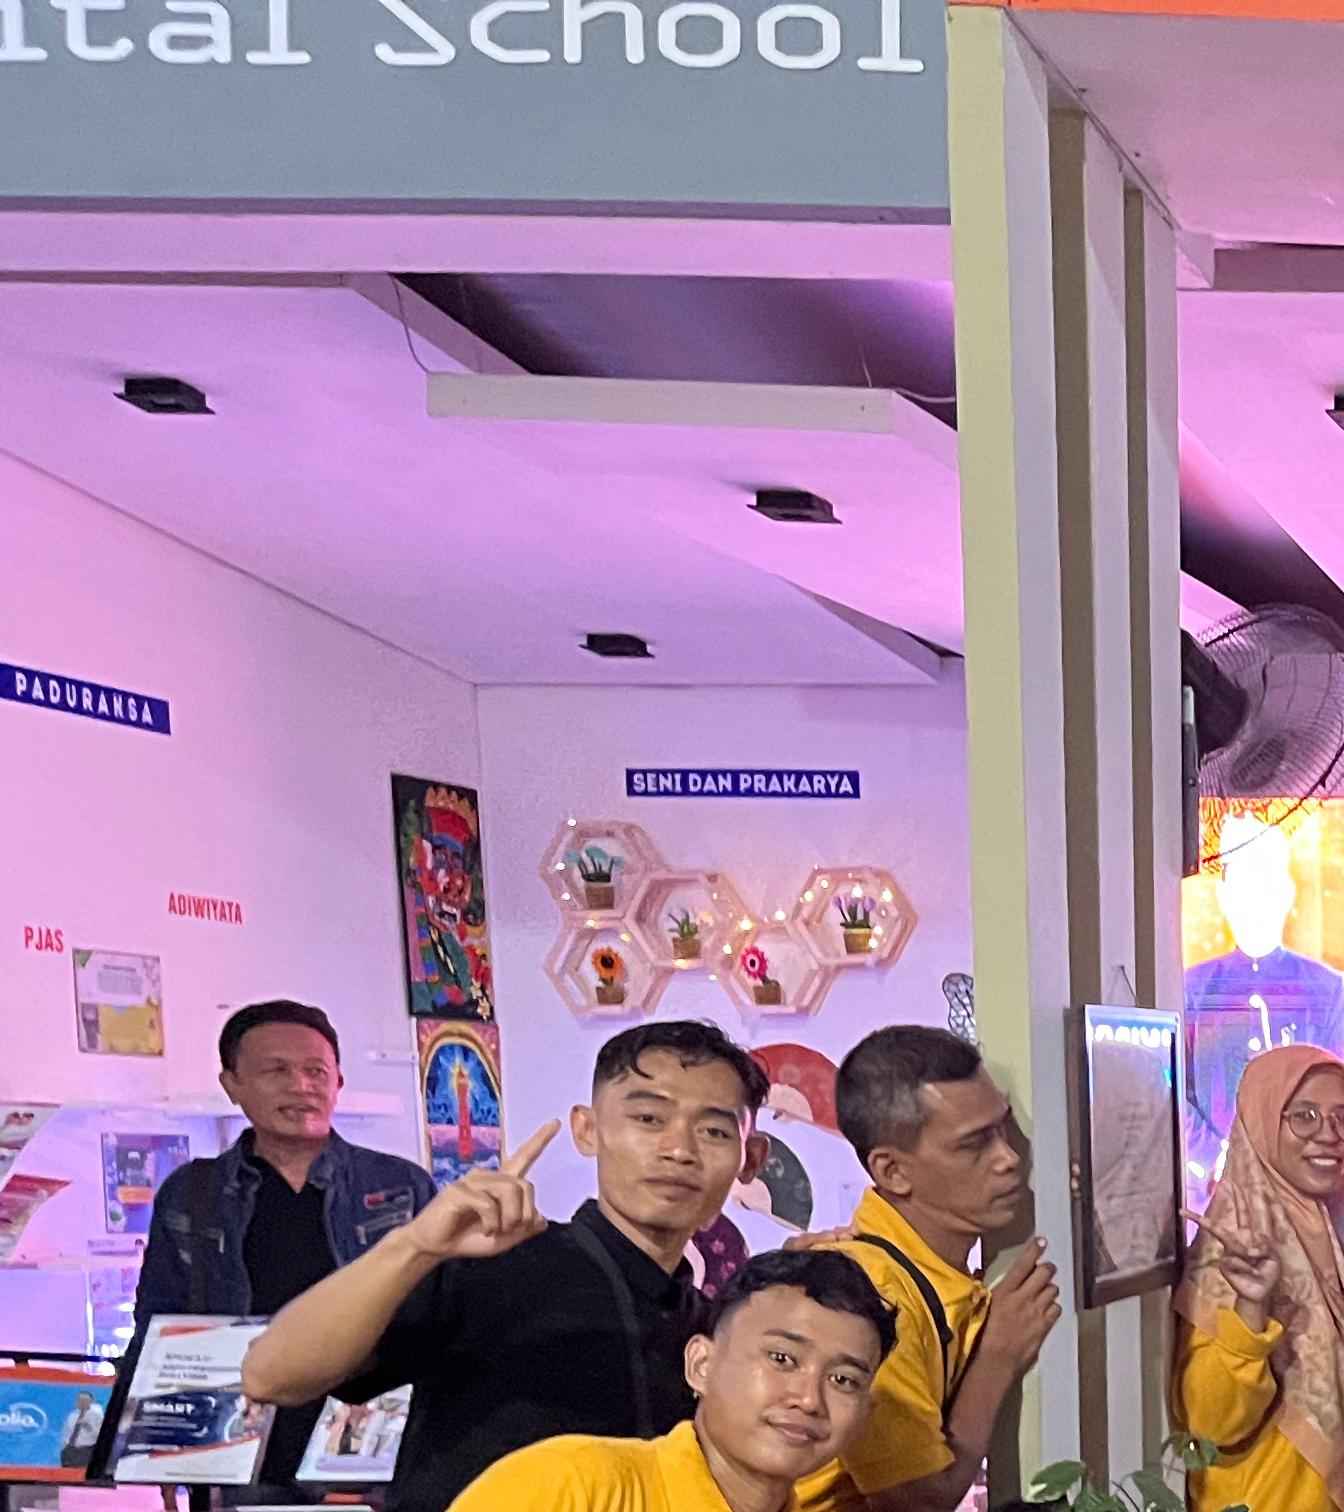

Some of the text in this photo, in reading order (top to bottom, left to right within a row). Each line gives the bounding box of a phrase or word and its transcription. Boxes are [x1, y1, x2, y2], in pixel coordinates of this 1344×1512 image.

[375, 0, 925, 73] School
[15, 671, 153, 726] PADURAKSA
[633, 772, 854, 795] SENI DAN PRAKARYA
[168, 892, 243, 925] ADIWIYATA
[24, 926, 64, 953] PJAS
